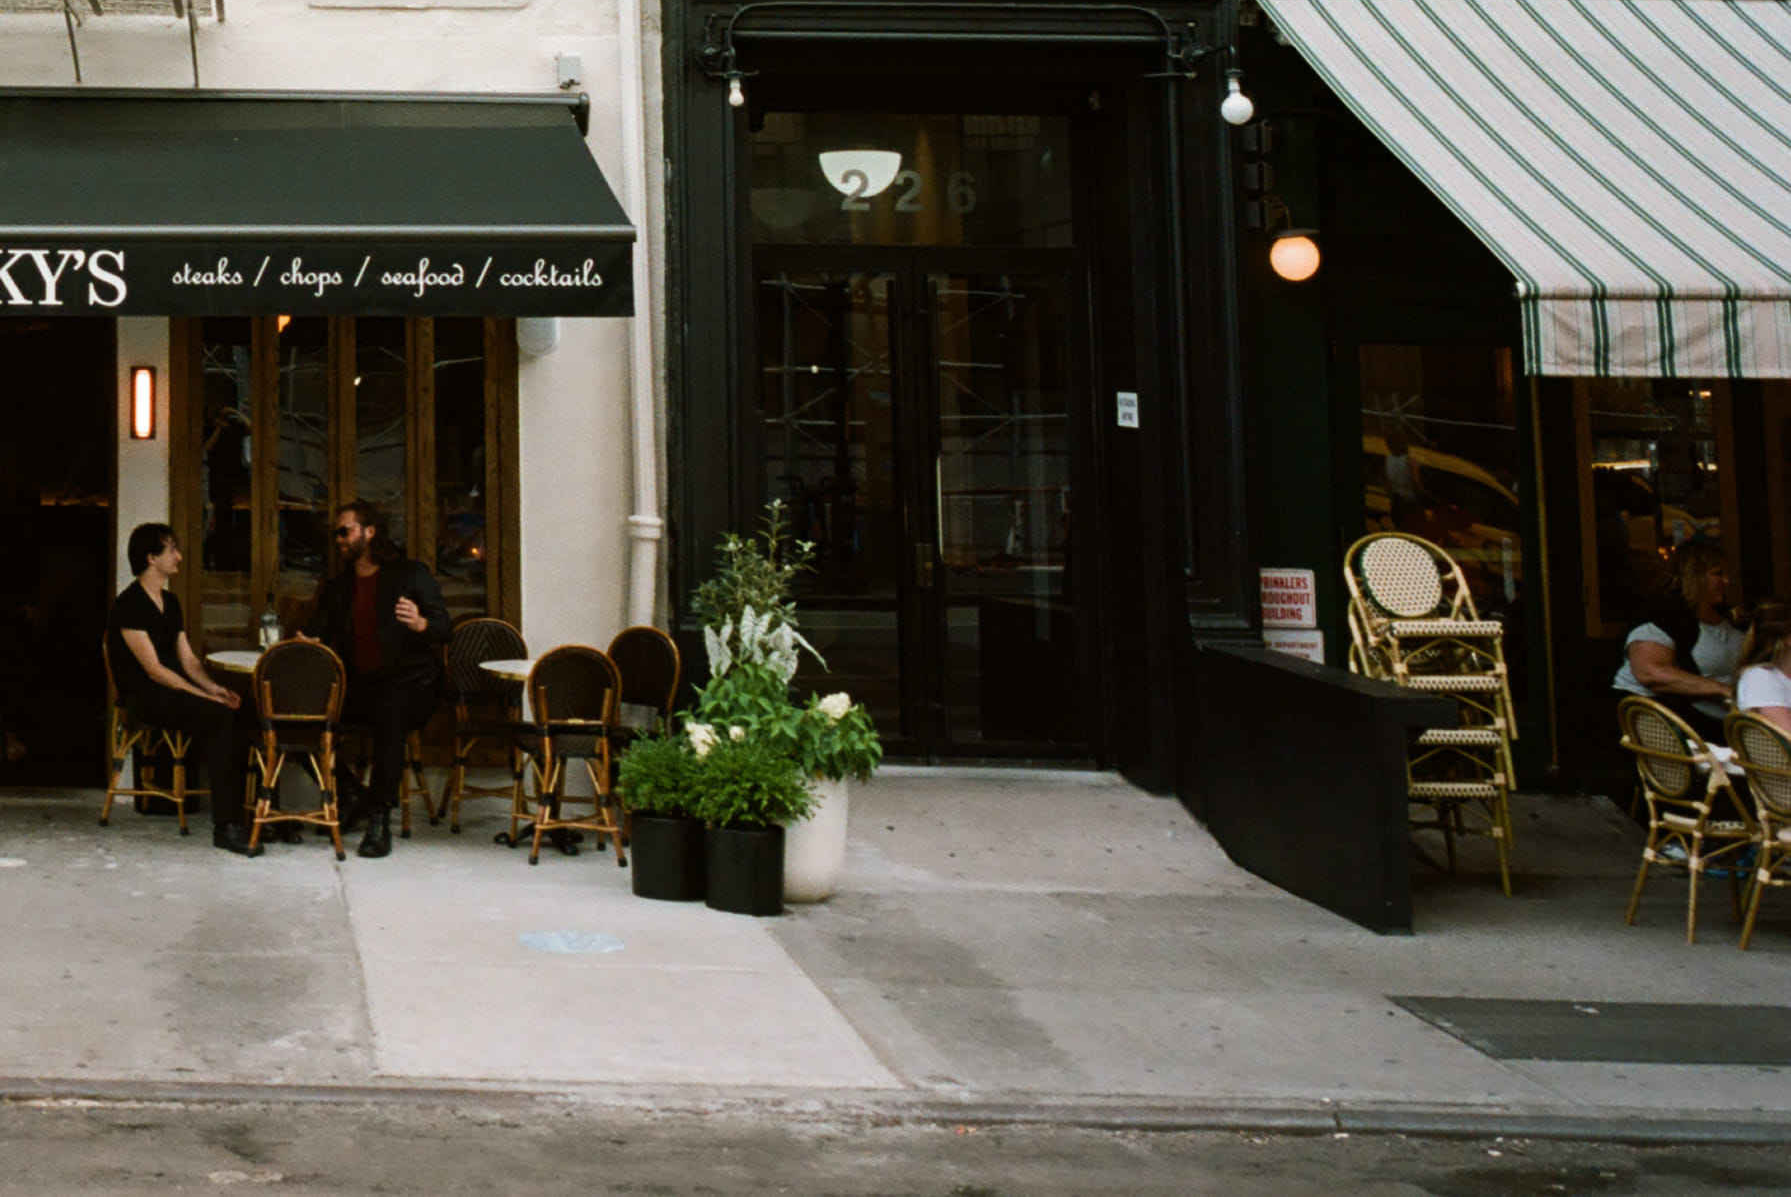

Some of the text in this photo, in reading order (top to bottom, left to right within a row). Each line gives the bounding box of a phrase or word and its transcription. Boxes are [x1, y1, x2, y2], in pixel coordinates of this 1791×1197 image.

[171, 256, 244, 287] steaks
[279, 256, 344, 298] chops
[380, 258, 465, 298] seafood
[498, 258, 605, 289] cocktails
